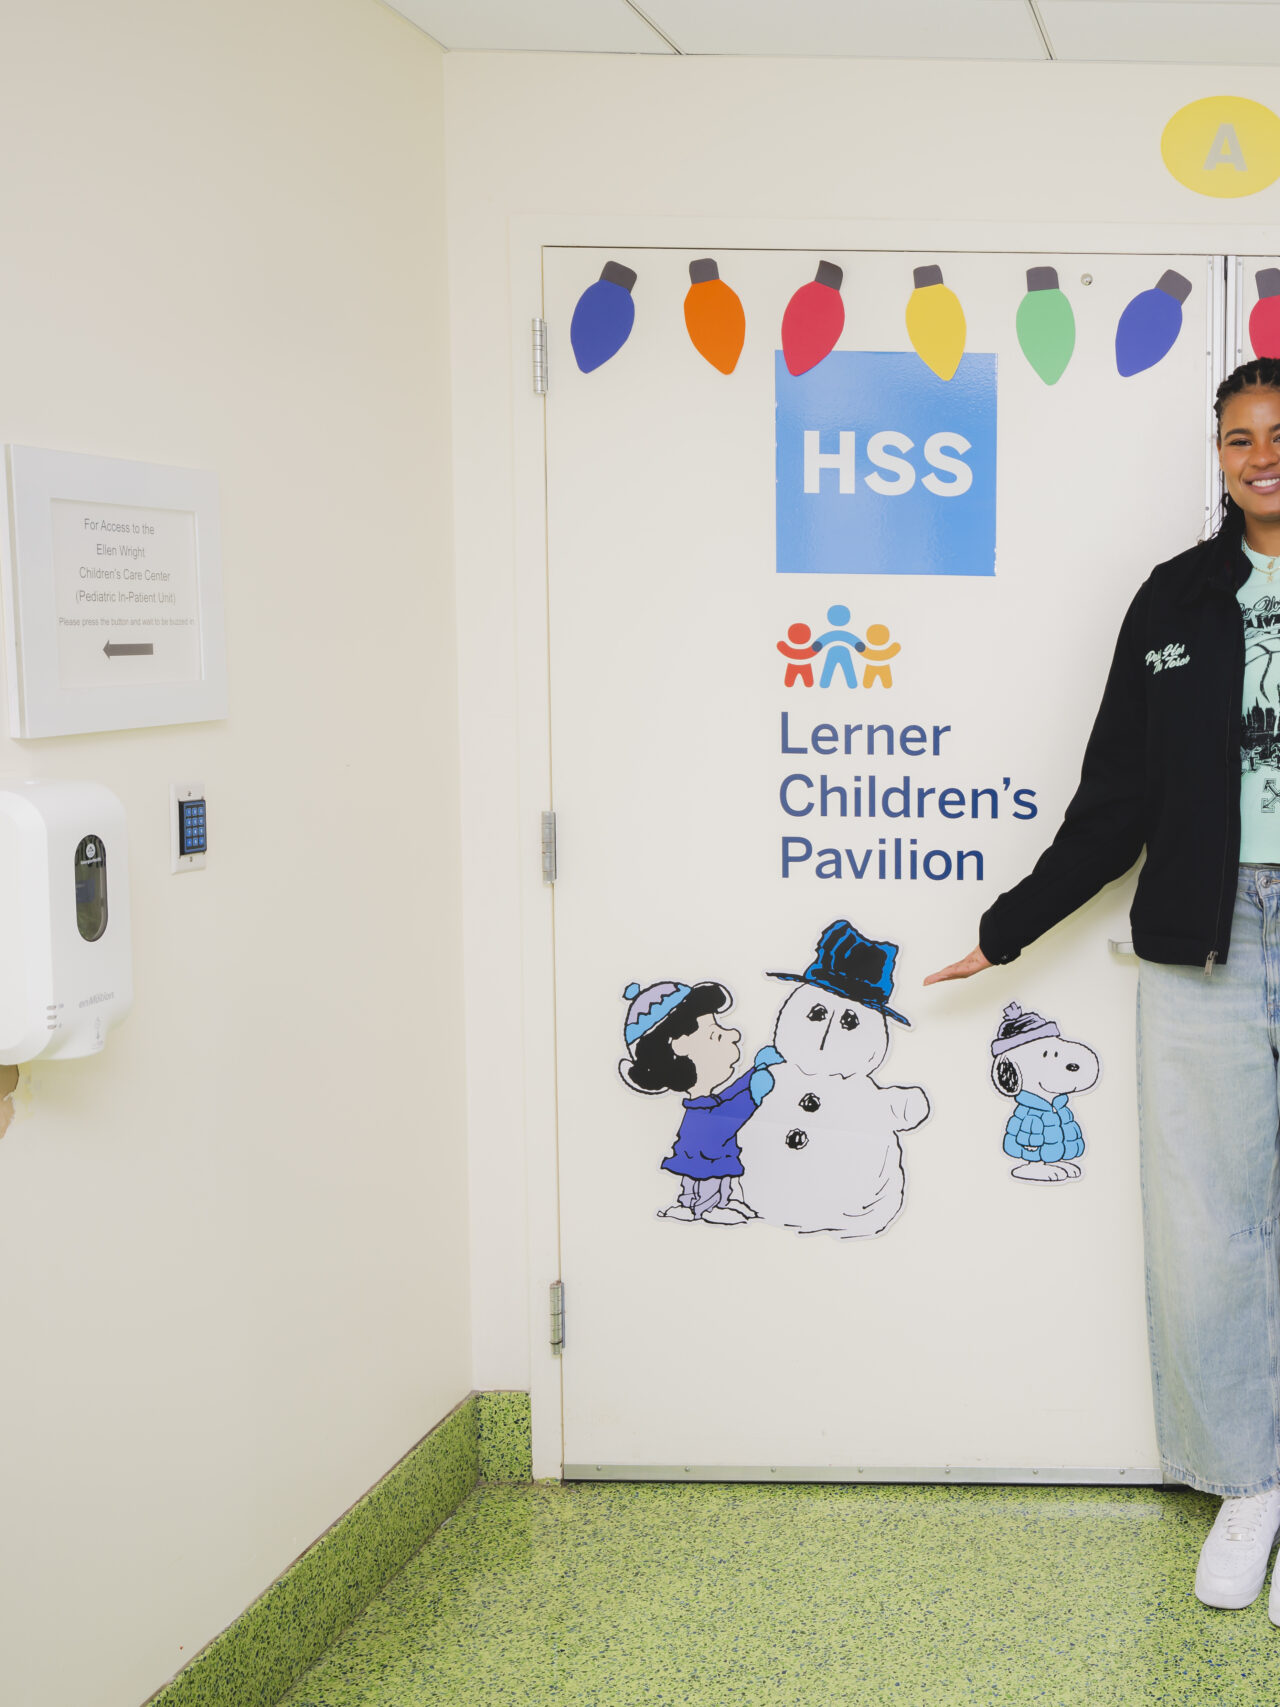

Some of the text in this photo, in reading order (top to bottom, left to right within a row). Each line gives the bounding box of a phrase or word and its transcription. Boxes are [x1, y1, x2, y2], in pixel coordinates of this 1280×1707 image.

[1202, 122, 1248, 172] A
[803, 430, 973, 497] HSS
[84, 518, 155, 535] For Access to the
[96, 543, 146, 560] Ellen Wright
[79, 566, 171, 582] Children's Care Center
[75, 590, 176, 606] (Pediatric In-Patient Unit)
[59, 617, 81, 627] Please
[781, 711, 951, 756] Lerner
[779, 774, 1038, 820] Children's
[781, 836, 984, 880] Pavilion
